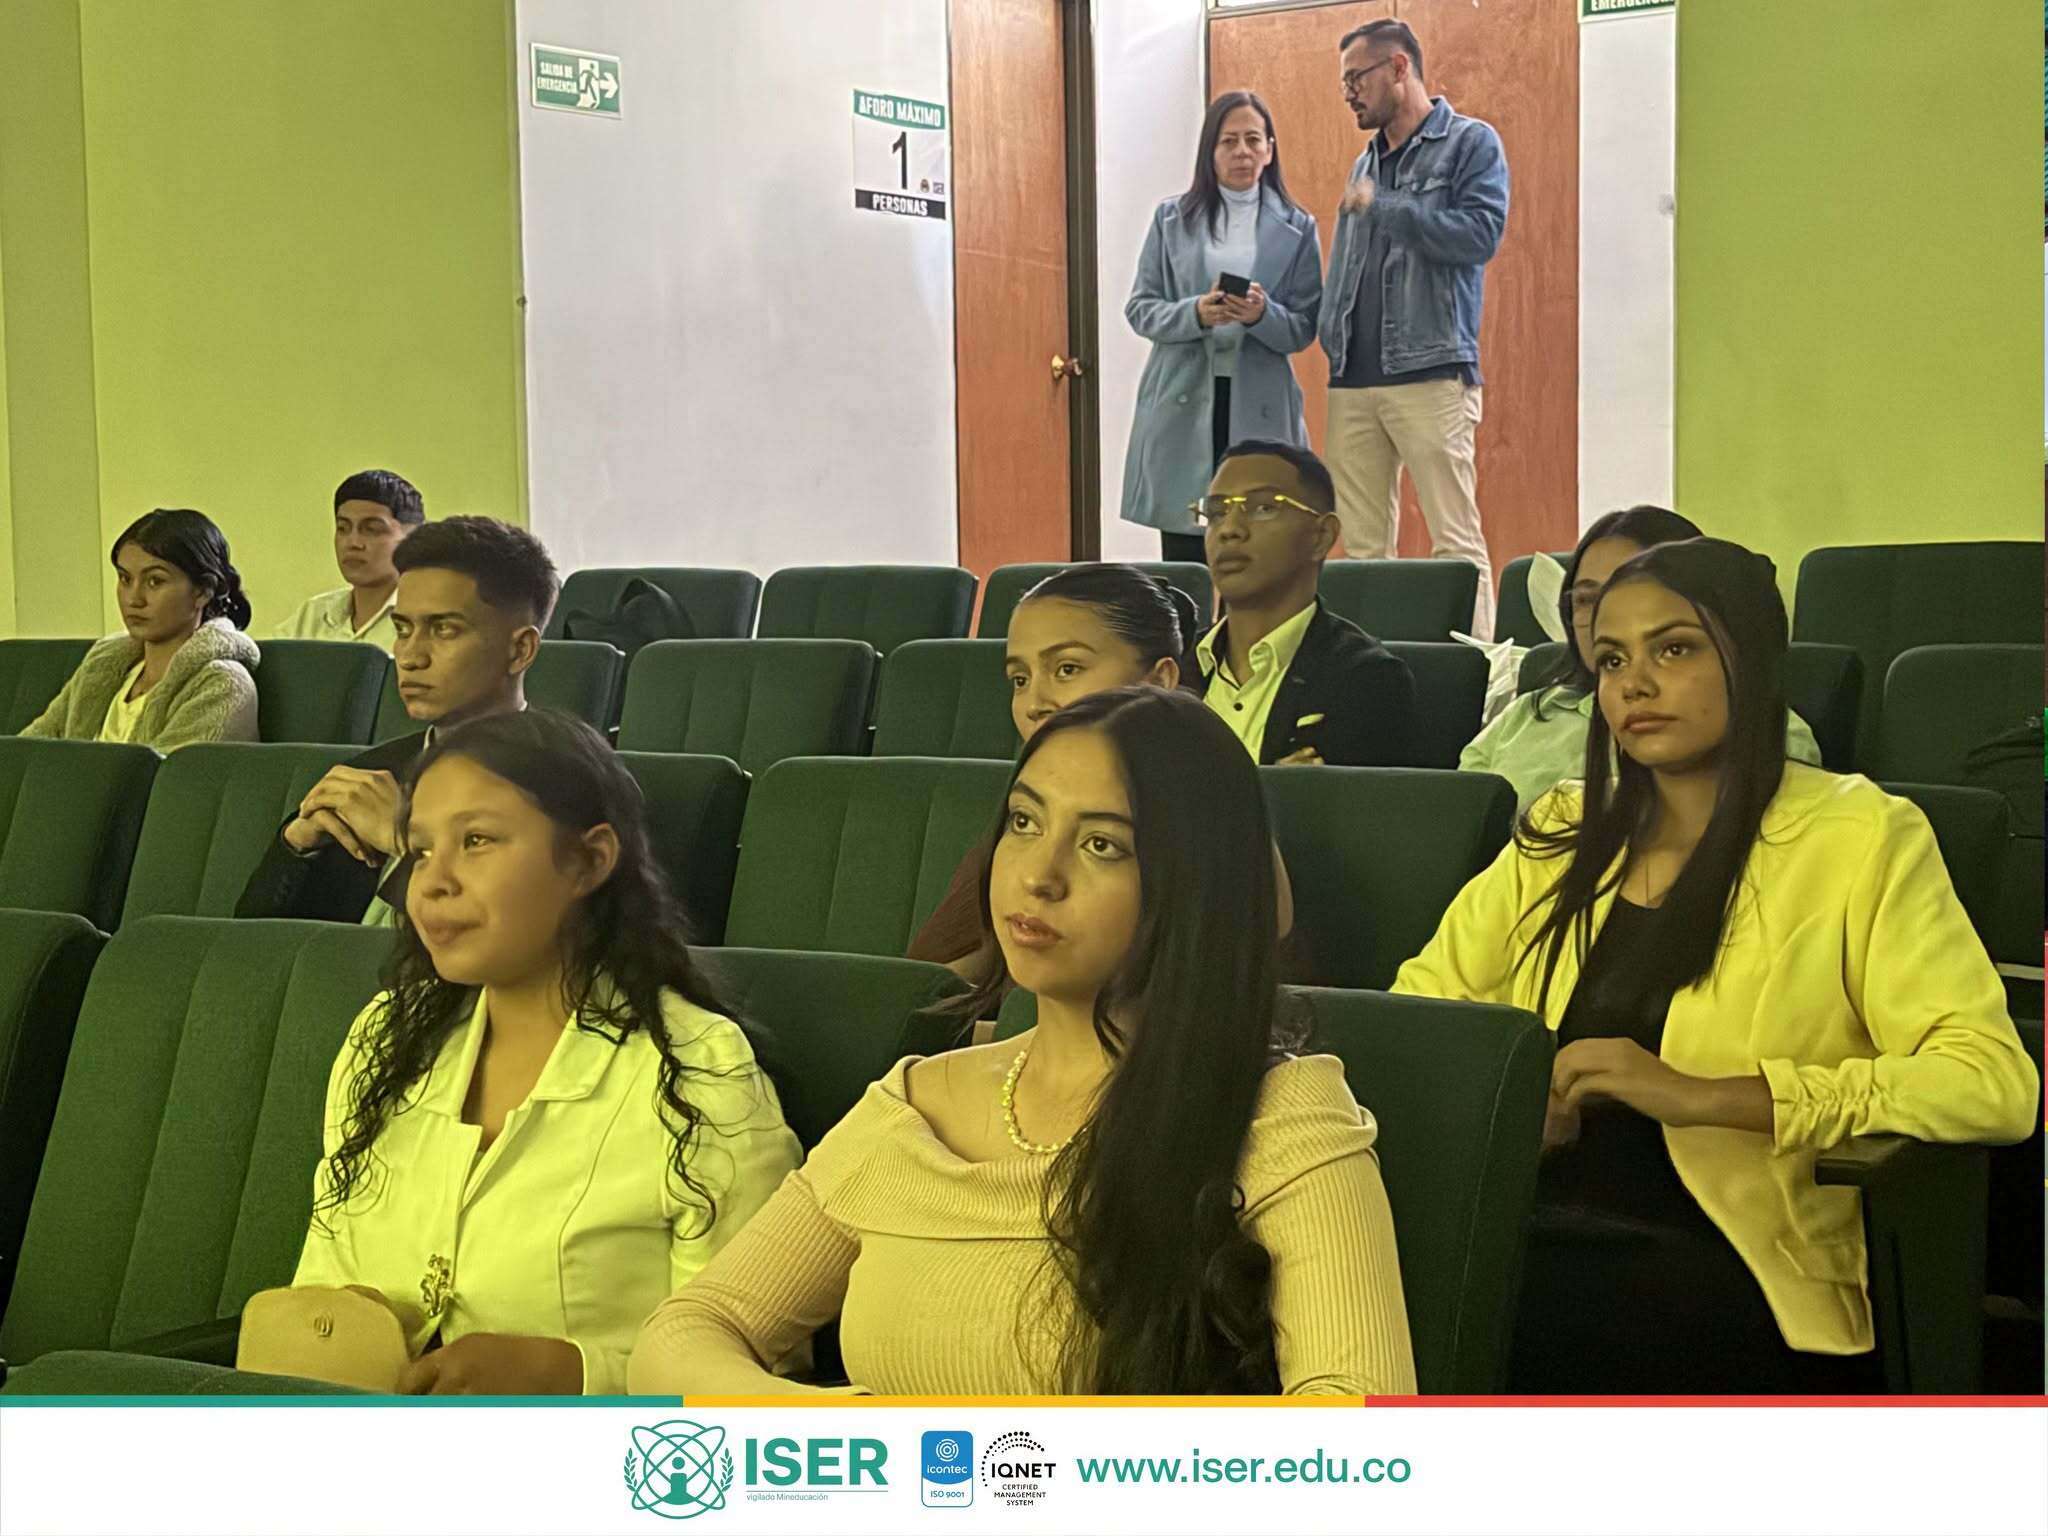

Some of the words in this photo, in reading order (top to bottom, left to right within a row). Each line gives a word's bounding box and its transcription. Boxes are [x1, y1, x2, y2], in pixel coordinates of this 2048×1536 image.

[859, 95, 894, 118] AFORO
[896, 101, 941, 127] MÁXIMO
[892, 131, 908, 190] 1
[872, 194, 928, 216] PERSONAS
